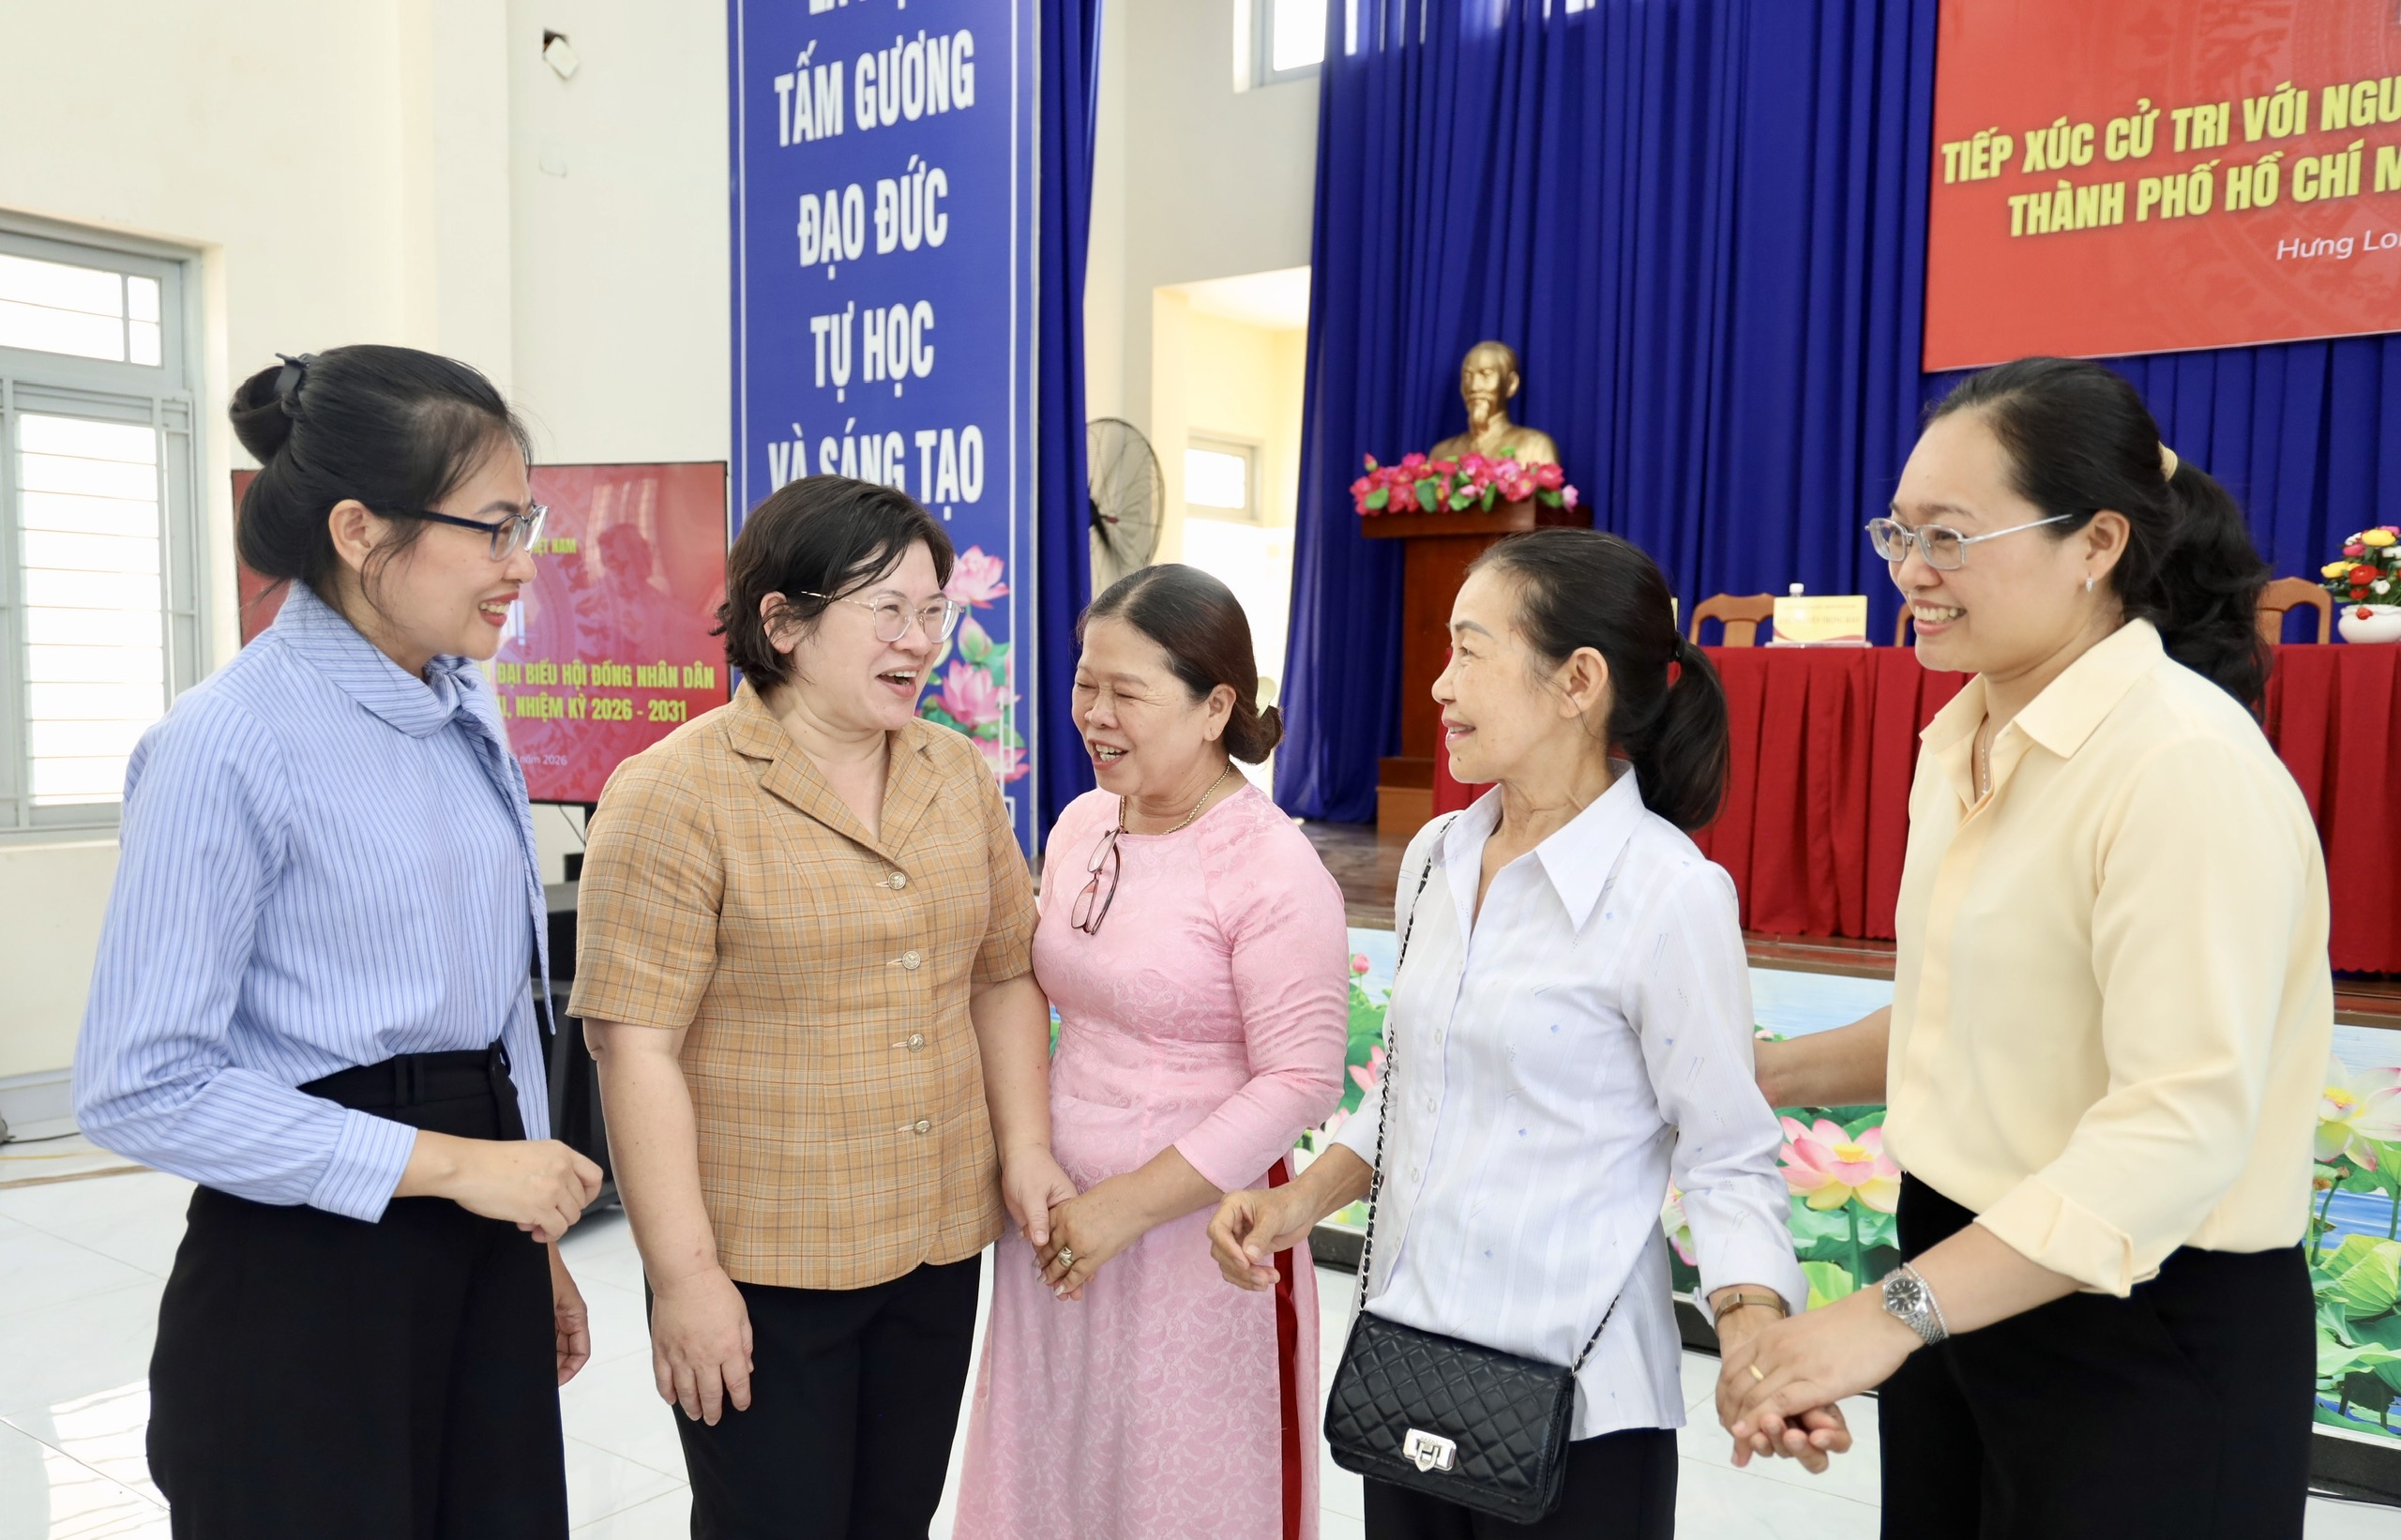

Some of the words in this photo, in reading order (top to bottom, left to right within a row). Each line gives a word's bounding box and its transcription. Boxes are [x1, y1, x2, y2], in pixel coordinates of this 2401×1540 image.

[775, 39, 843, 147] TẤM
[854, 29, 974, 131] GƯƠNG
[1941, 127, 2014, 184] TIẾP
[2022, 115, 2095, 174] XÚC
[2105, 98, 2161, 162] CỬ
[2171, 102, 2230, 152] TRI
[2242, 81, 2308, 142] VỚI
[797, 183, 865, 279] ĐẠO
[874, 154, 948, 255] ĐỨC
[2008, 179, 2125, 237] THÀNH
[2136, 159, 2221, 222] PHỐ
[2292, 138, 2364, 203] CHÍ
[2276, 236, 2354, 261] Hưng
[810, 301, 854, 403] TỰ
[863, 300, 934, 398] HỌC
[819, 417, 905, 493] SÁNG
[915, 425, 984, 521] TẠO
[497, 662, 521, 689] ĐẠI
[563, 659, 587, 690] HỘI
[637, 659, 678, 687] NHÂN
[683, 660, 715, 689] DÂN
[517, 691, 564, 723] NHIỆM
[567, 693, 587, 719] KỲ
[591, 698, 633, 720] 2026
[648, 700, 687, 722] 2031
[543, 754, 567, 766] 2026
